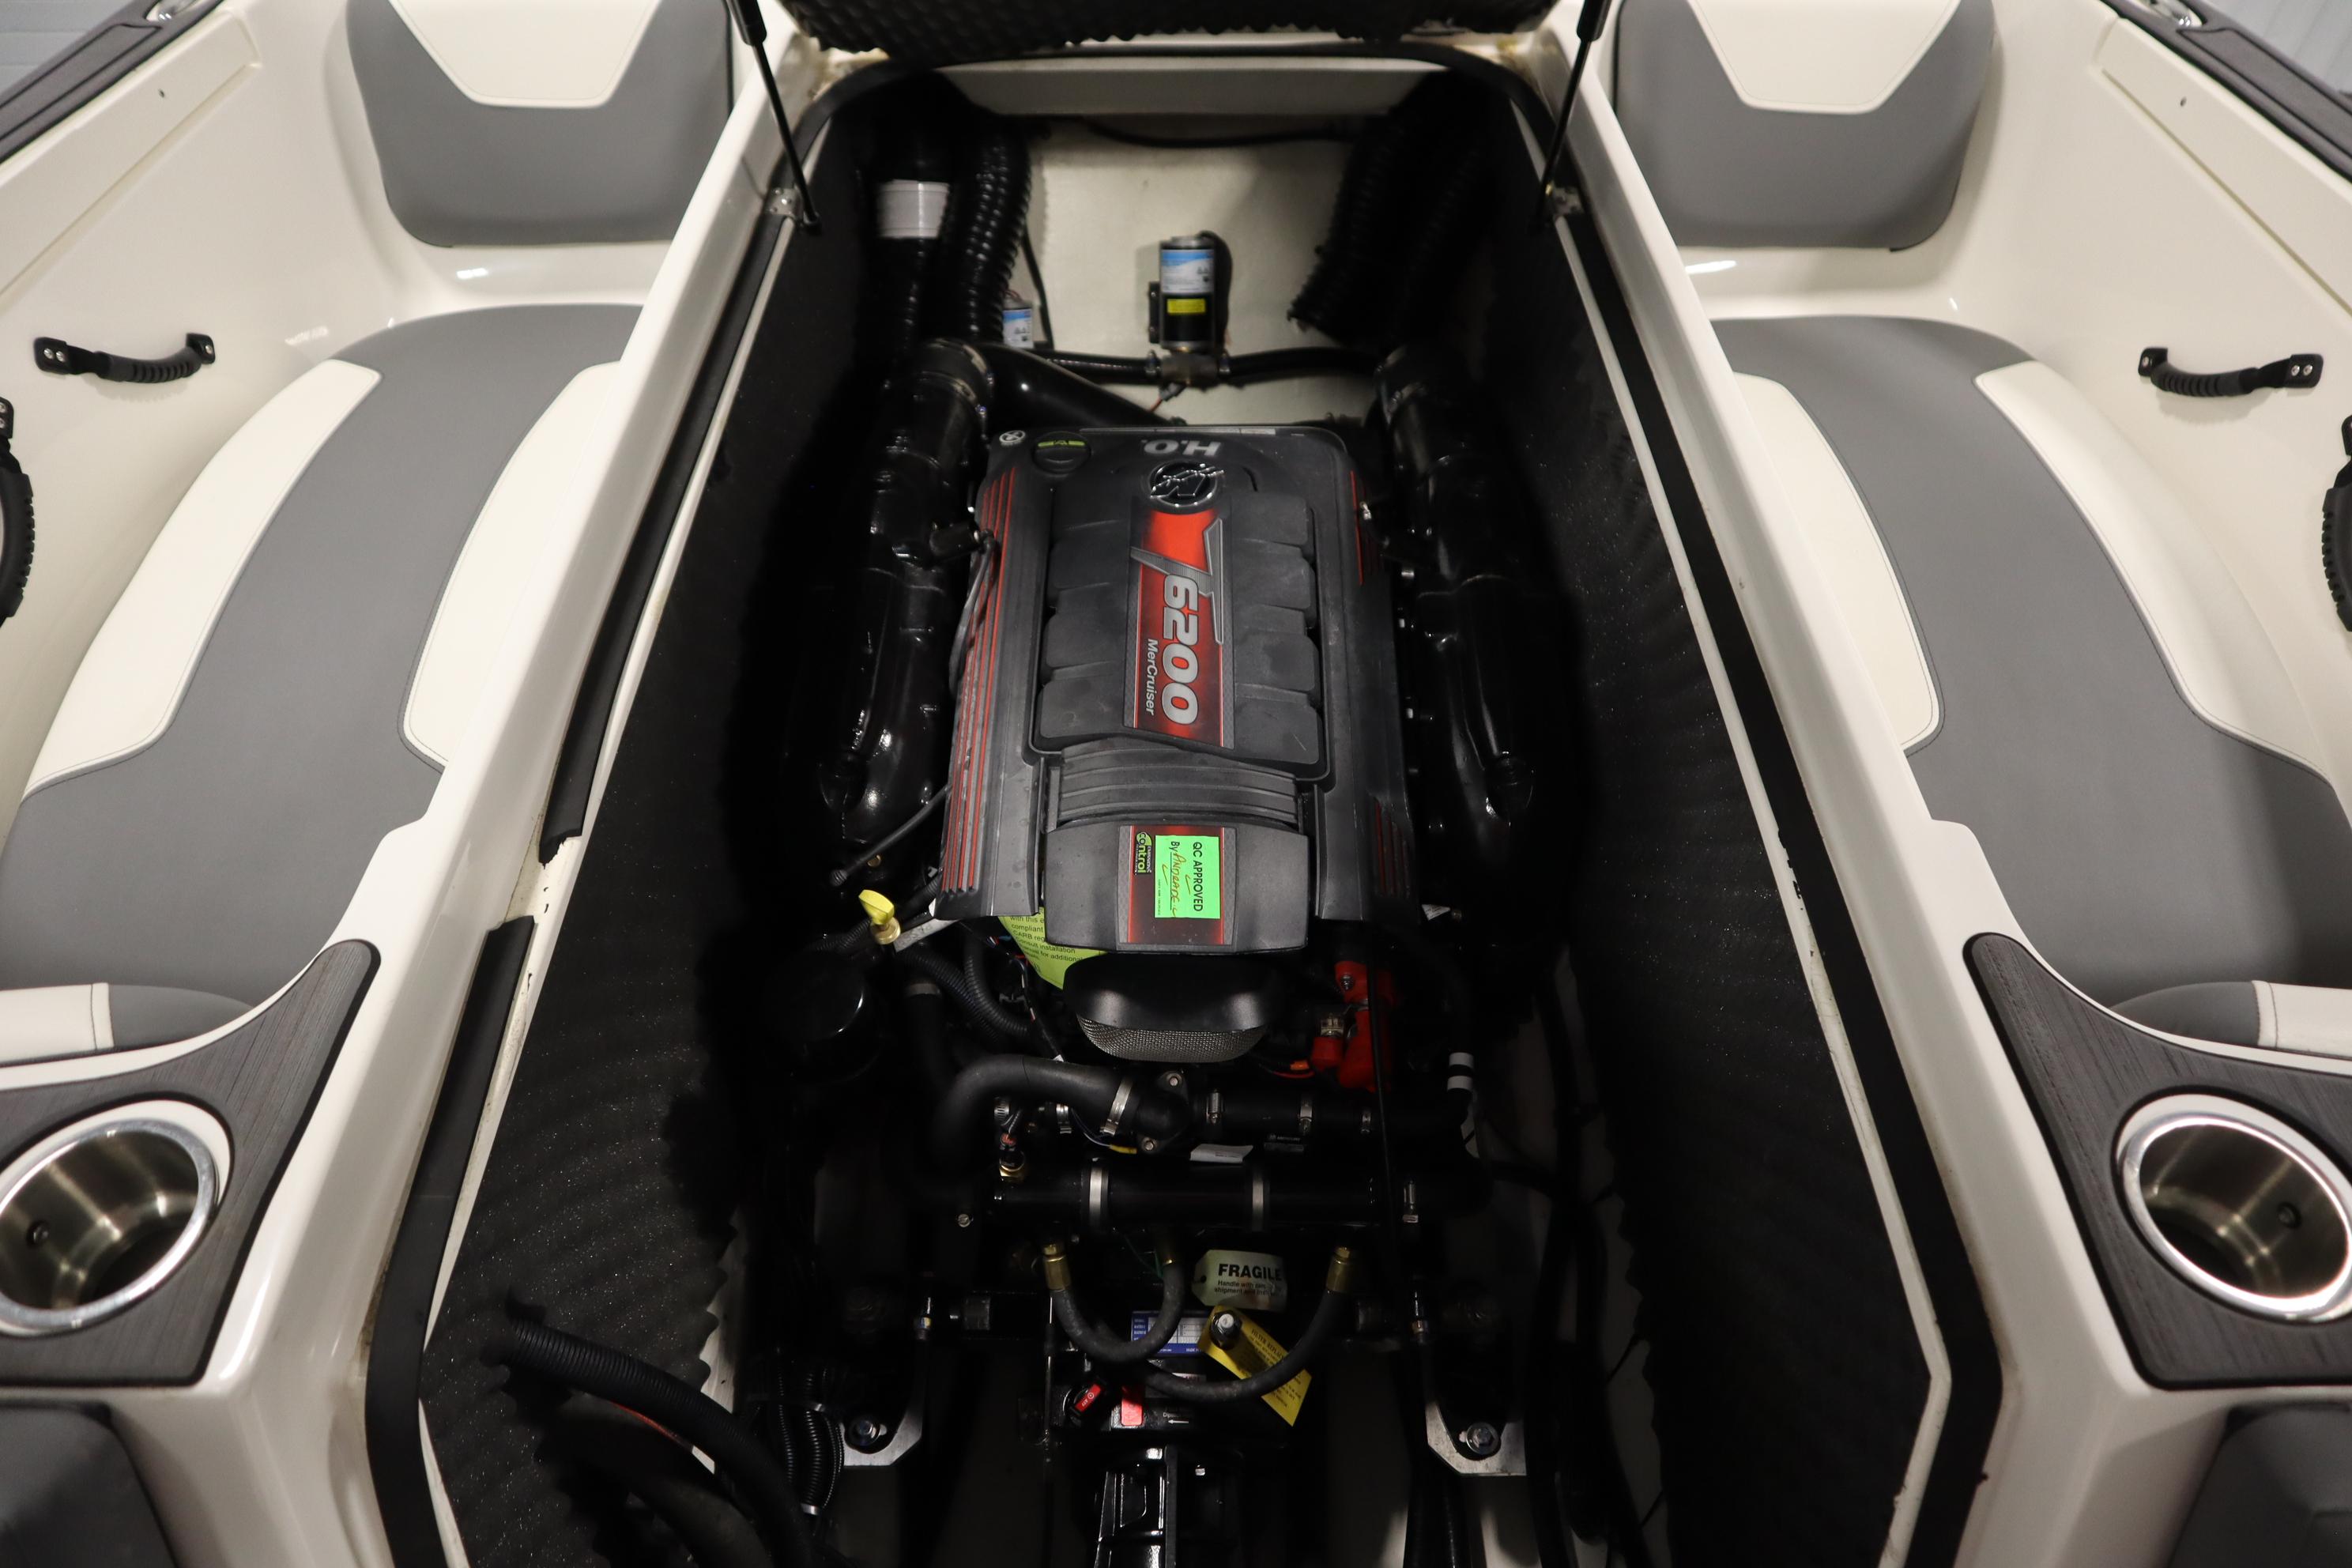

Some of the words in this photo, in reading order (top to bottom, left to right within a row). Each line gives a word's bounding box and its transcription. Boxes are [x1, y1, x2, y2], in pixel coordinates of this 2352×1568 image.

[1162, 574, 1199, 726] 6200
[1145, 638, 1159, 717] MerCruiser
[1168, 841, 1181, 853] By
[1193, 842, 1203, 858] QC
[1193, 860, 1204, 912] APPROVED
[1011, 924, 1043, 933] compliant
[1012, 930, 1032, 940] CARB
[1039, 943, 1076, 954] installation
[1218, 1263, 1282, 1280] FRAGILE
